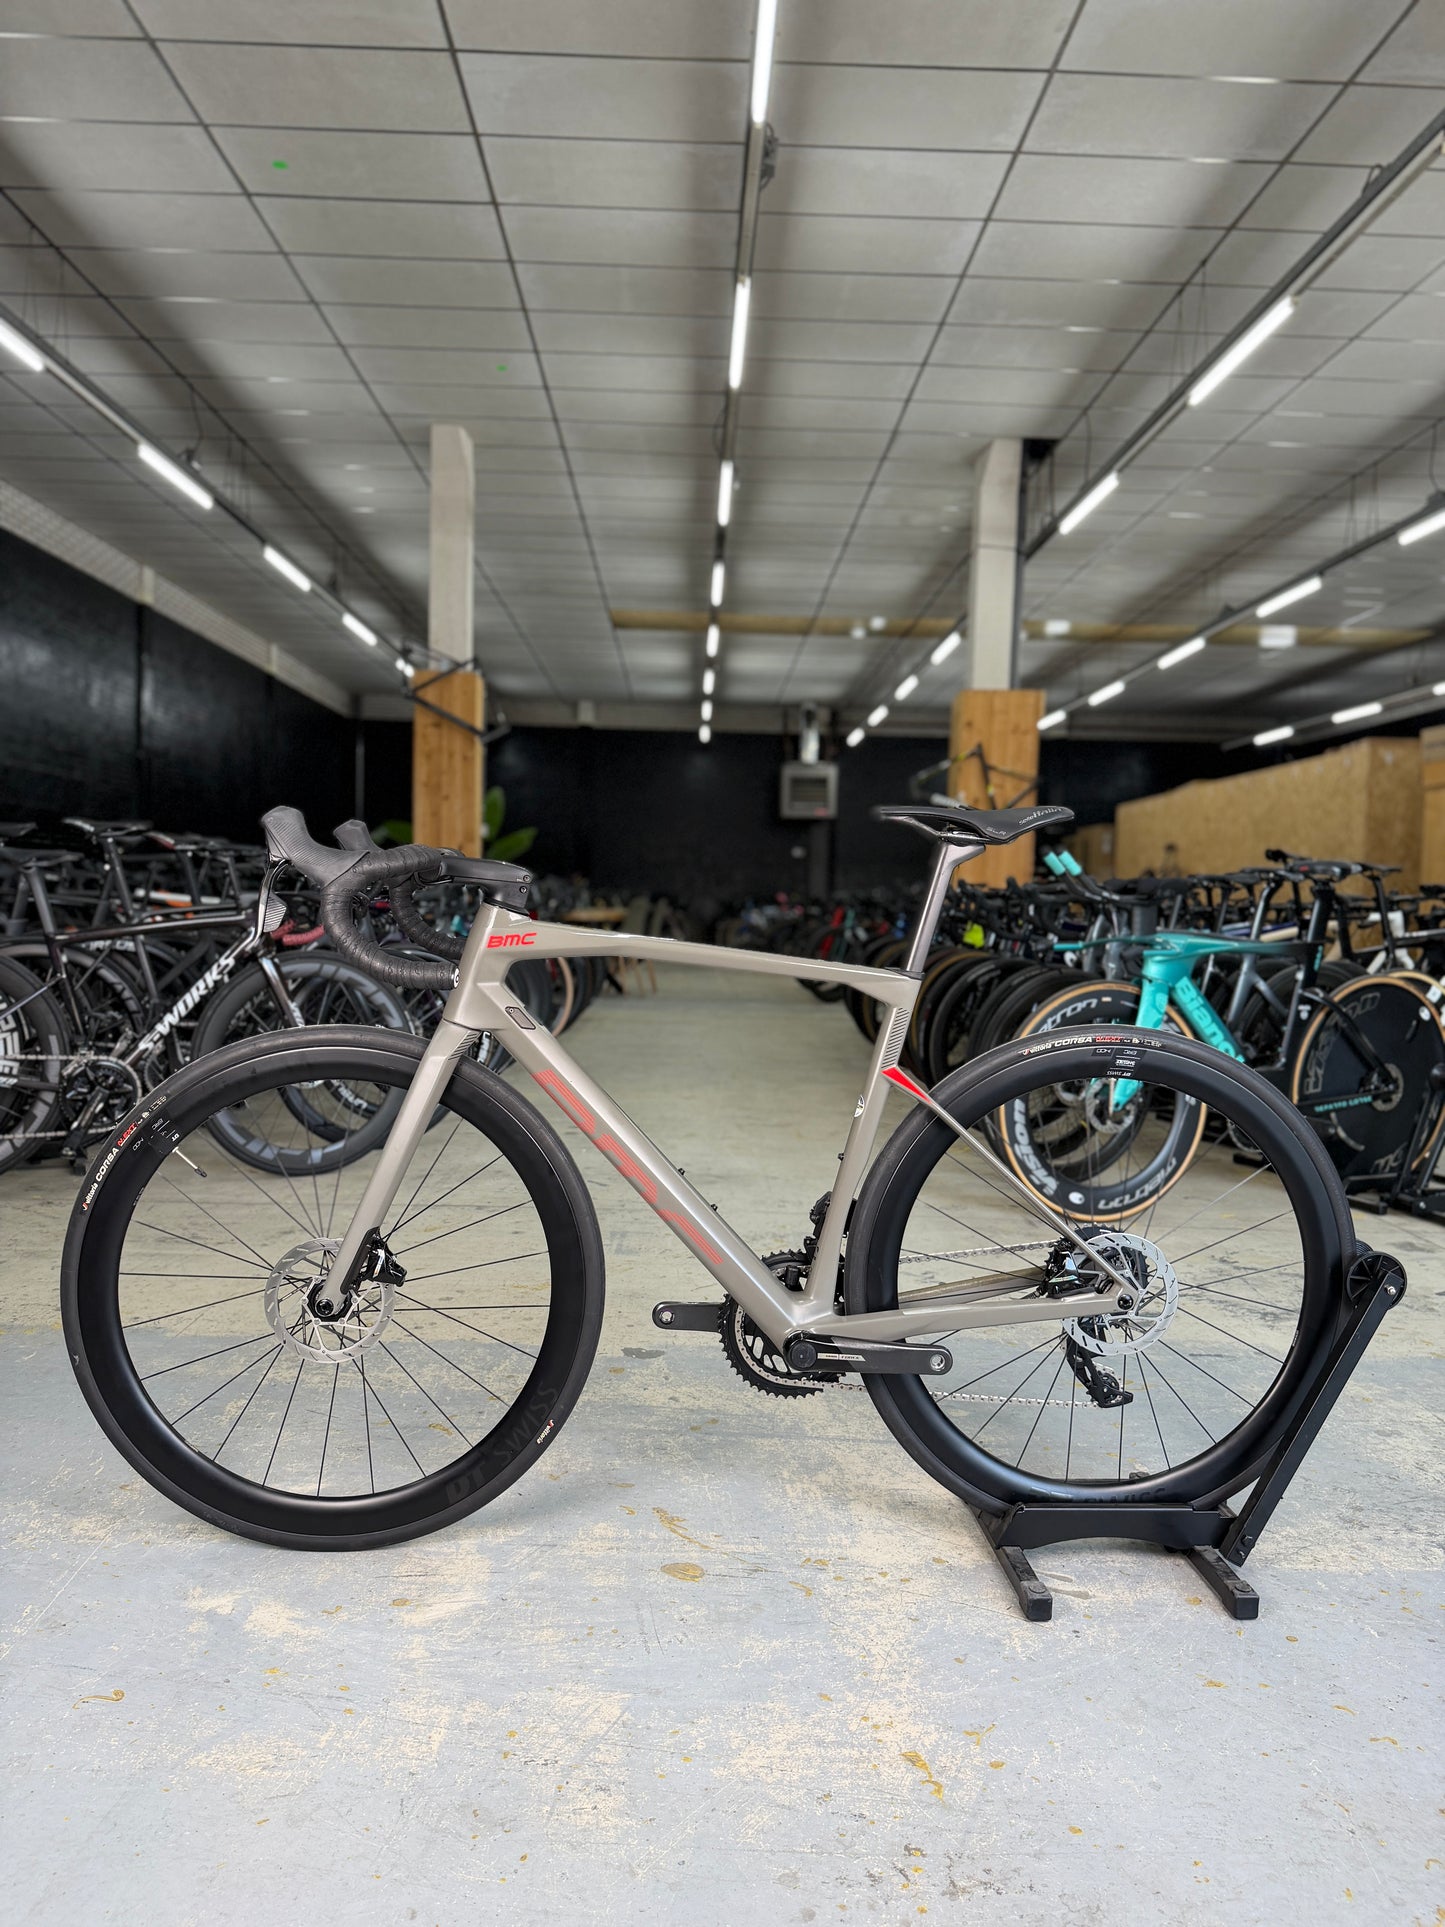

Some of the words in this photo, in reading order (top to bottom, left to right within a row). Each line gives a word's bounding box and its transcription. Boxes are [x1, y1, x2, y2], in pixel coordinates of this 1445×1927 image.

[487, 932, 537, 949] BMC
[138, 955, 236, 1051] S-WORKS
[1054, 1036, 1093, 1047] CORSA
[83, 1182, 99, 1207] vittoria
[95, 1147, 119, 1182] CORSA
